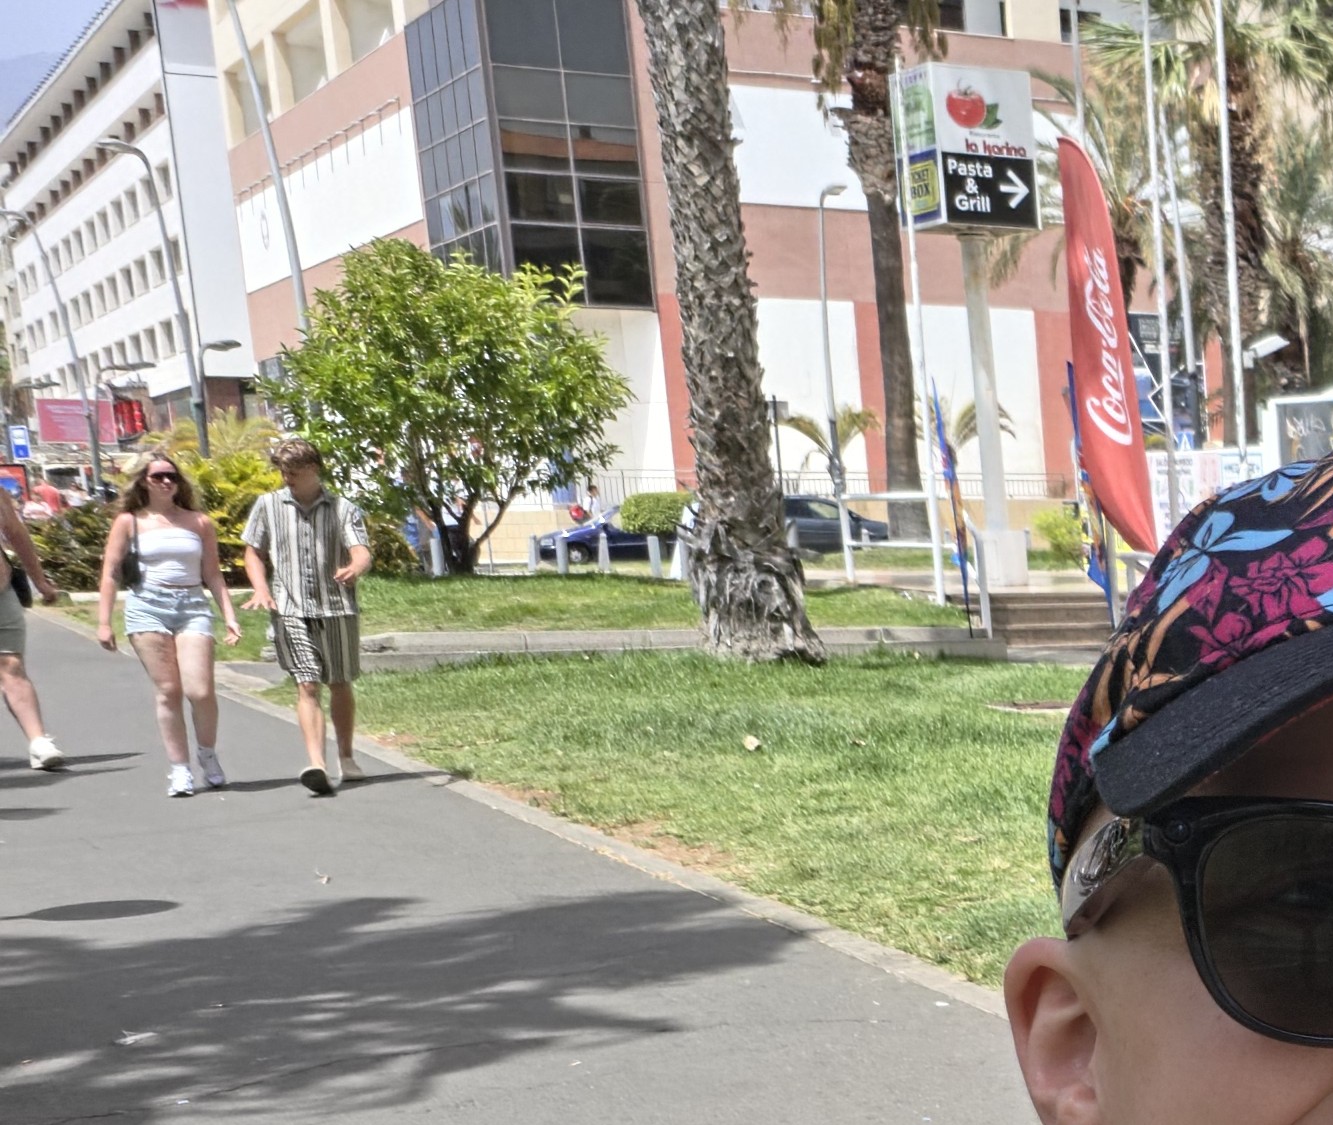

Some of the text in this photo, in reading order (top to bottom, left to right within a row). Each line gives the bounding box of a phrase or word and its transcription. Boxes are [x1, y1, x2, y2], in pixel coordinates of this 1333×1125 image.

[947, 158, 994, 179] Pasta
[965, 178, 979, 195] &
[955, 195, 992, 213] Grill
[1084, 243, 1134, 446] Coca-Cola
